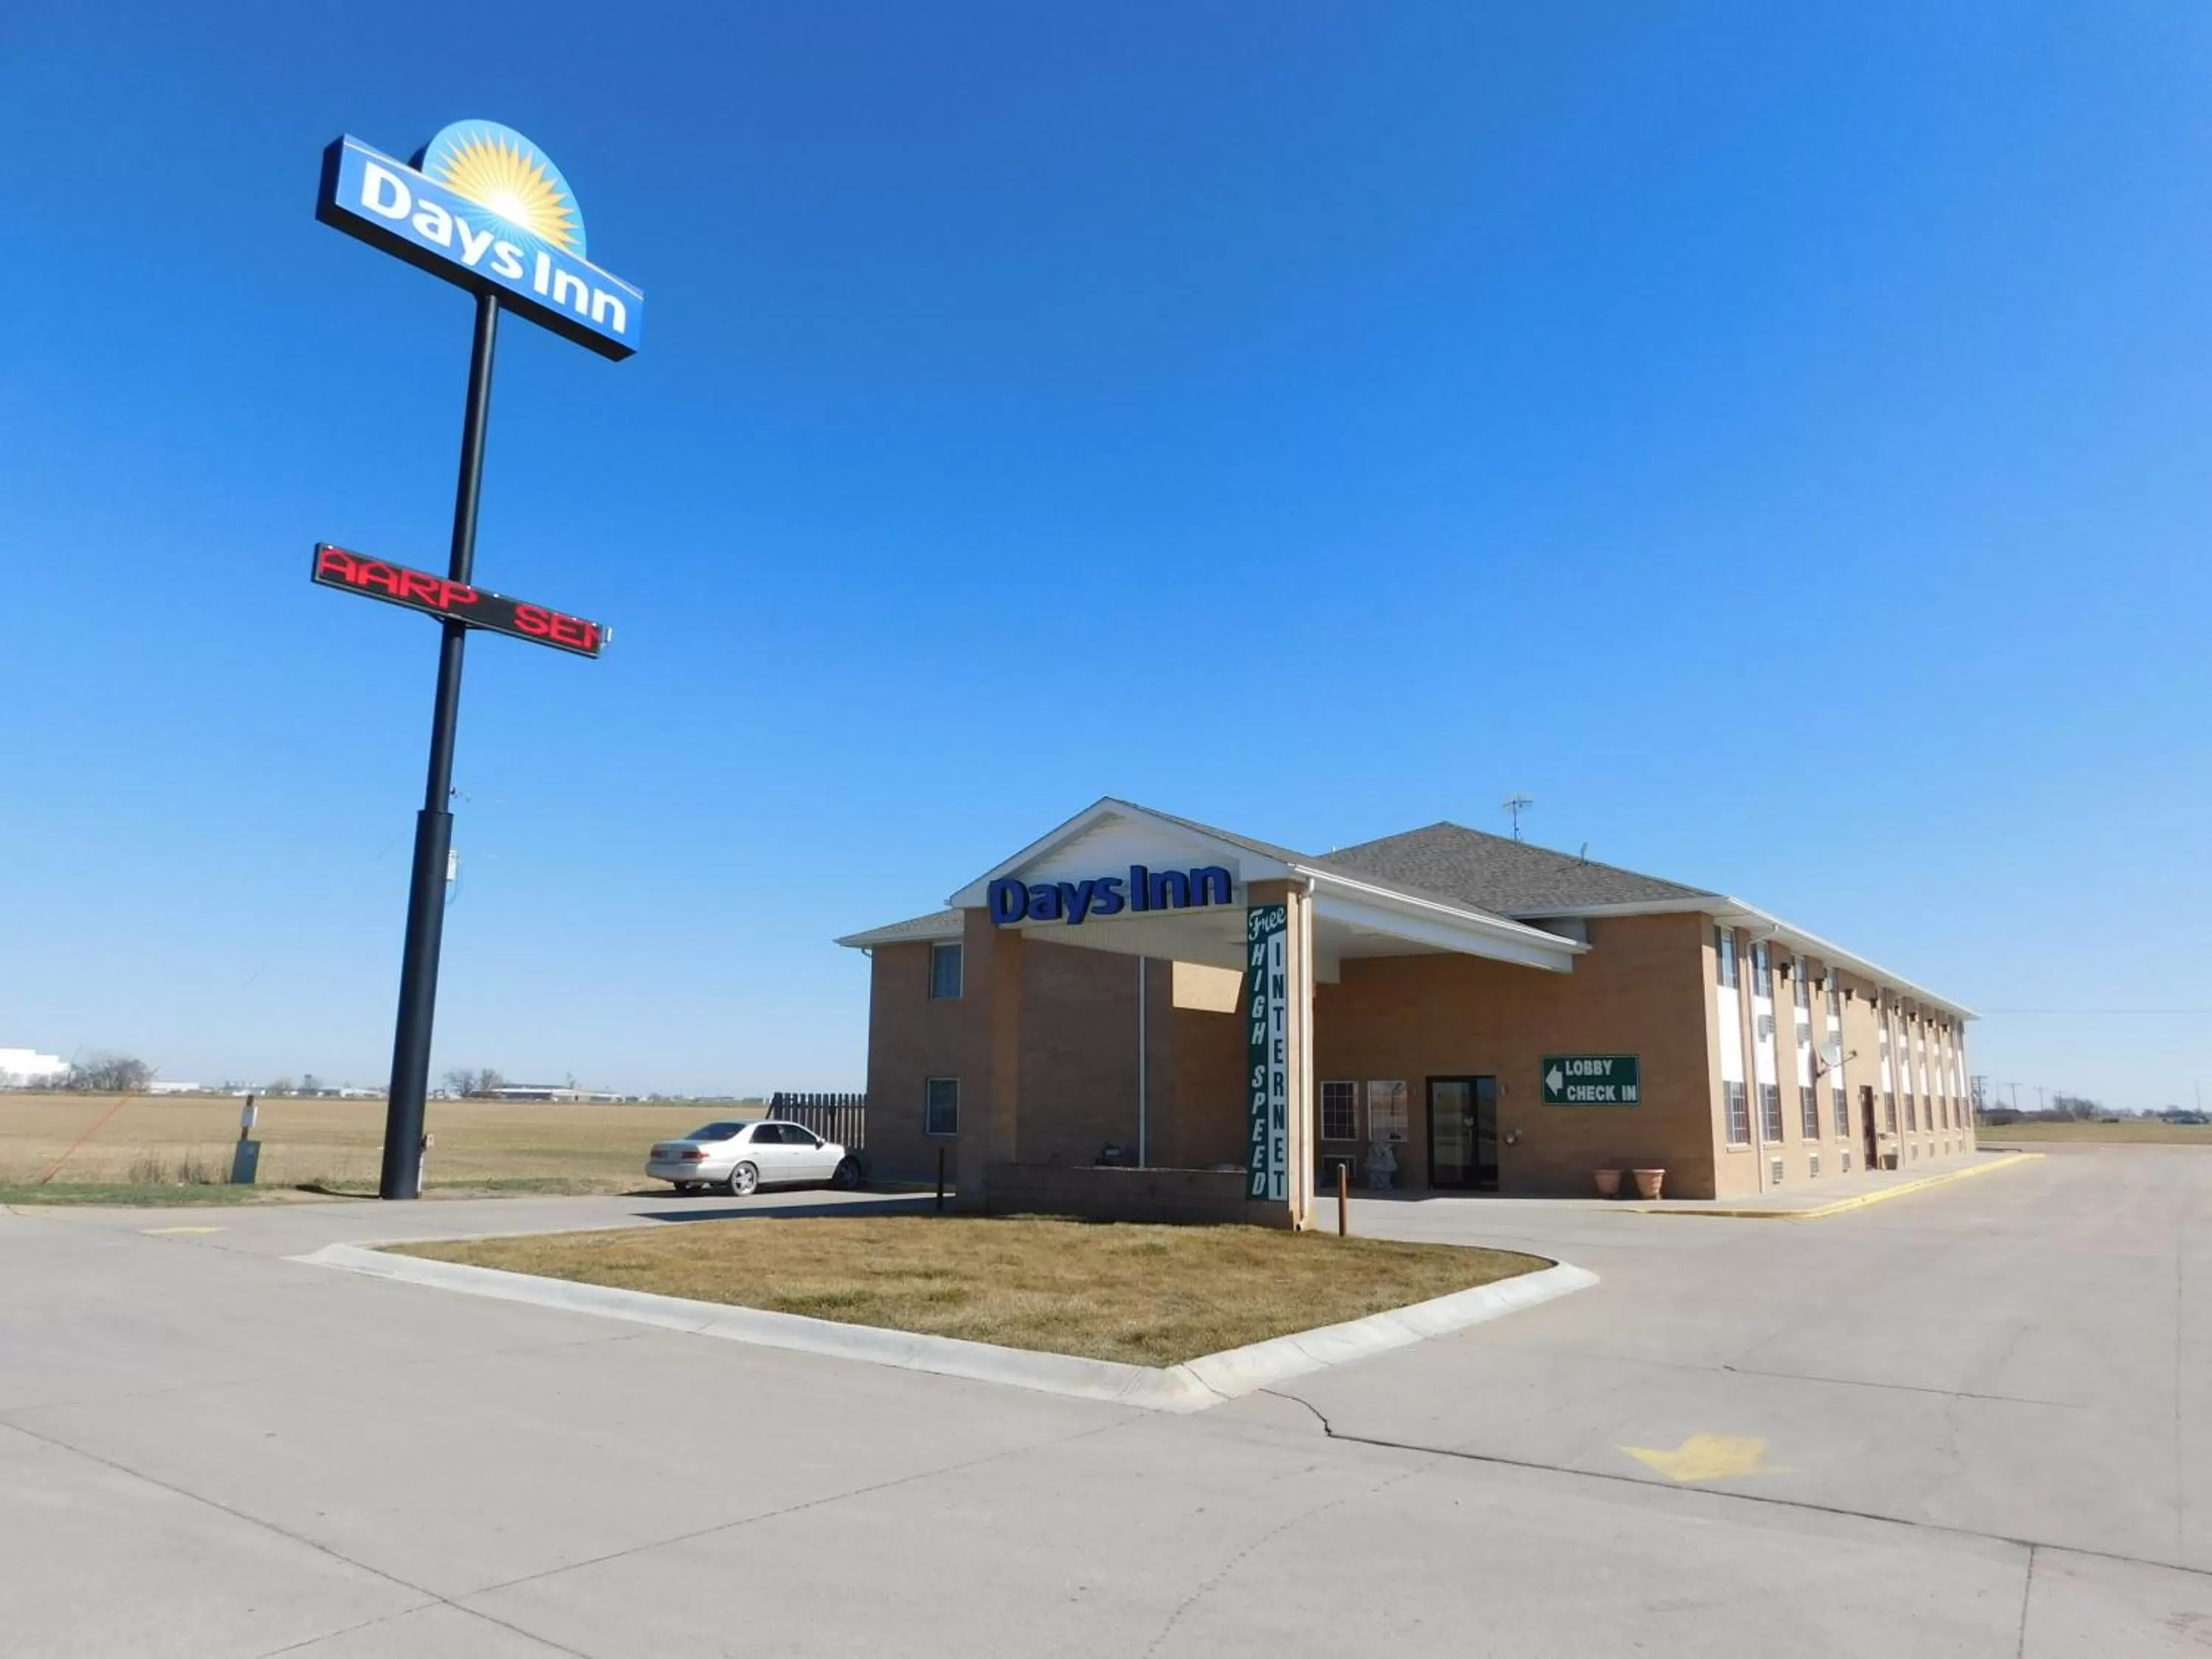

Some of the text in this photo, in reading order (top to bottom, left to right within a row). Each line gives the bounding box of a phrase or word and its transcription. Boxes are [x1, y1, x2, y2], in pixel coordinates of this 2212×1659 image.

[361, 161, 626, 334] Days Inn
[318, 548, 478, 609] AARP
[989, 865, 1232, 925] Days Inn
[1248, 908, 1287, 941] Free
[1251, 943, 1266, 1195] HIGH SPEED
[1272, 942, 1285, 1197] INTERNET
[1565, 1060, 1613, 1076] LOBBY
[1567, 1085, 1637, 1101] CHECK IN
